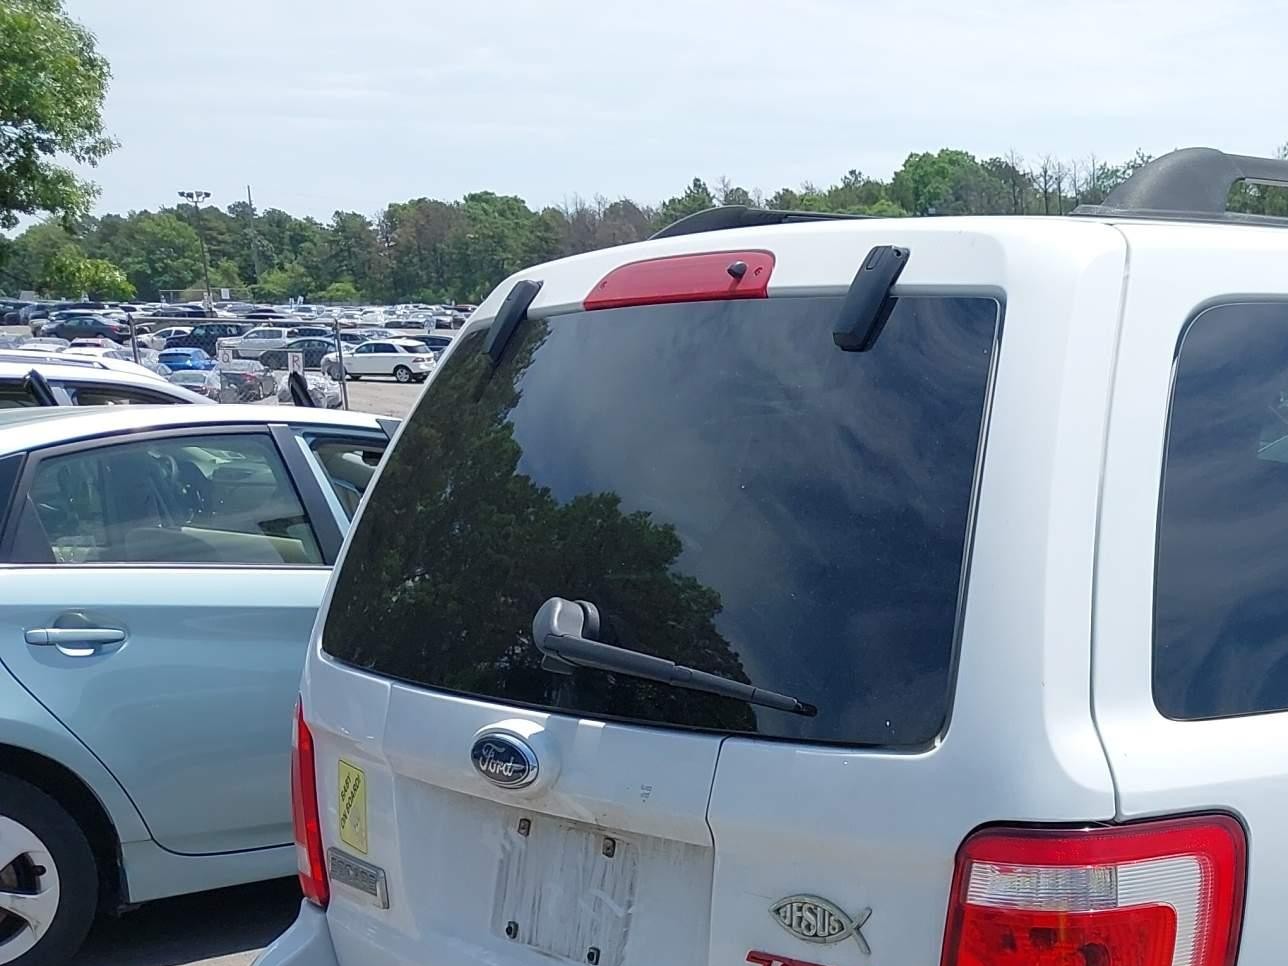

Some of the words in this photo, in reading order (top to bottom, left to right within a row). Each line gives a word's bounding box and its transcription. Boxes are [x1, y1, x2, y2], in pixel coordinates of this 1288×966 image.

[292, 355, 300, 372] R
[480, 742, 526, 777] Ford
[777, 902, 844, 937] JESUS
